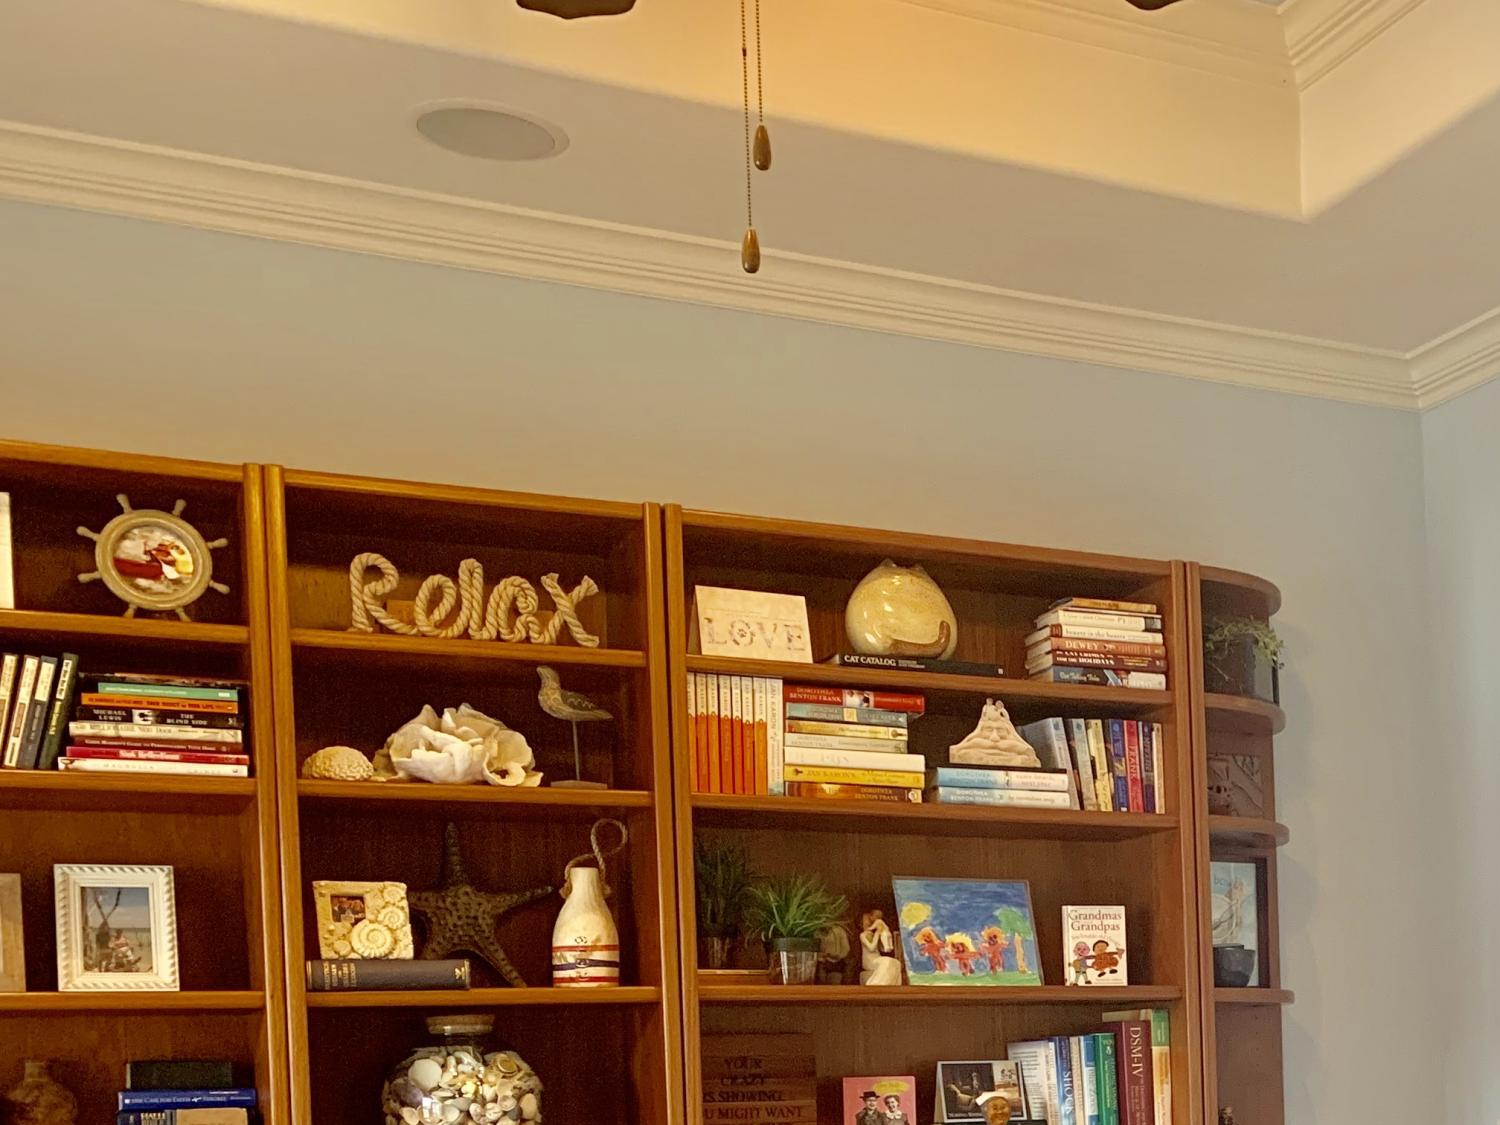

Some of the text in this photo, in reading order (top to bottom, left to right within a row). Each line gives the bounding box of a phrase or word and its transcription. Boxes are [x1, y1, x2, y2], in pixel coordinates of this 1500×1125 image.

[350, 552, 599, 648] Relax
[703, 616, 806, 651] LOVE
[1065, 641, 1099, 650] DEWEY
[844, 655, 859, 663] CAT
[860, 656, 896, 666] CATALOG
[819, 695, 842, 703] FRANK
[1069, 909, 1122, 921] Grandmas
[1070, 920, 1120, 934] Grandpas
[1129, 1026, 1143, 1078] DSM-IV
[1063, 1071, 1074, 1115] SHOCK
[717, 1107, 760, 1119] MIGHT
[765, 1105, 801, 1118] WANT
